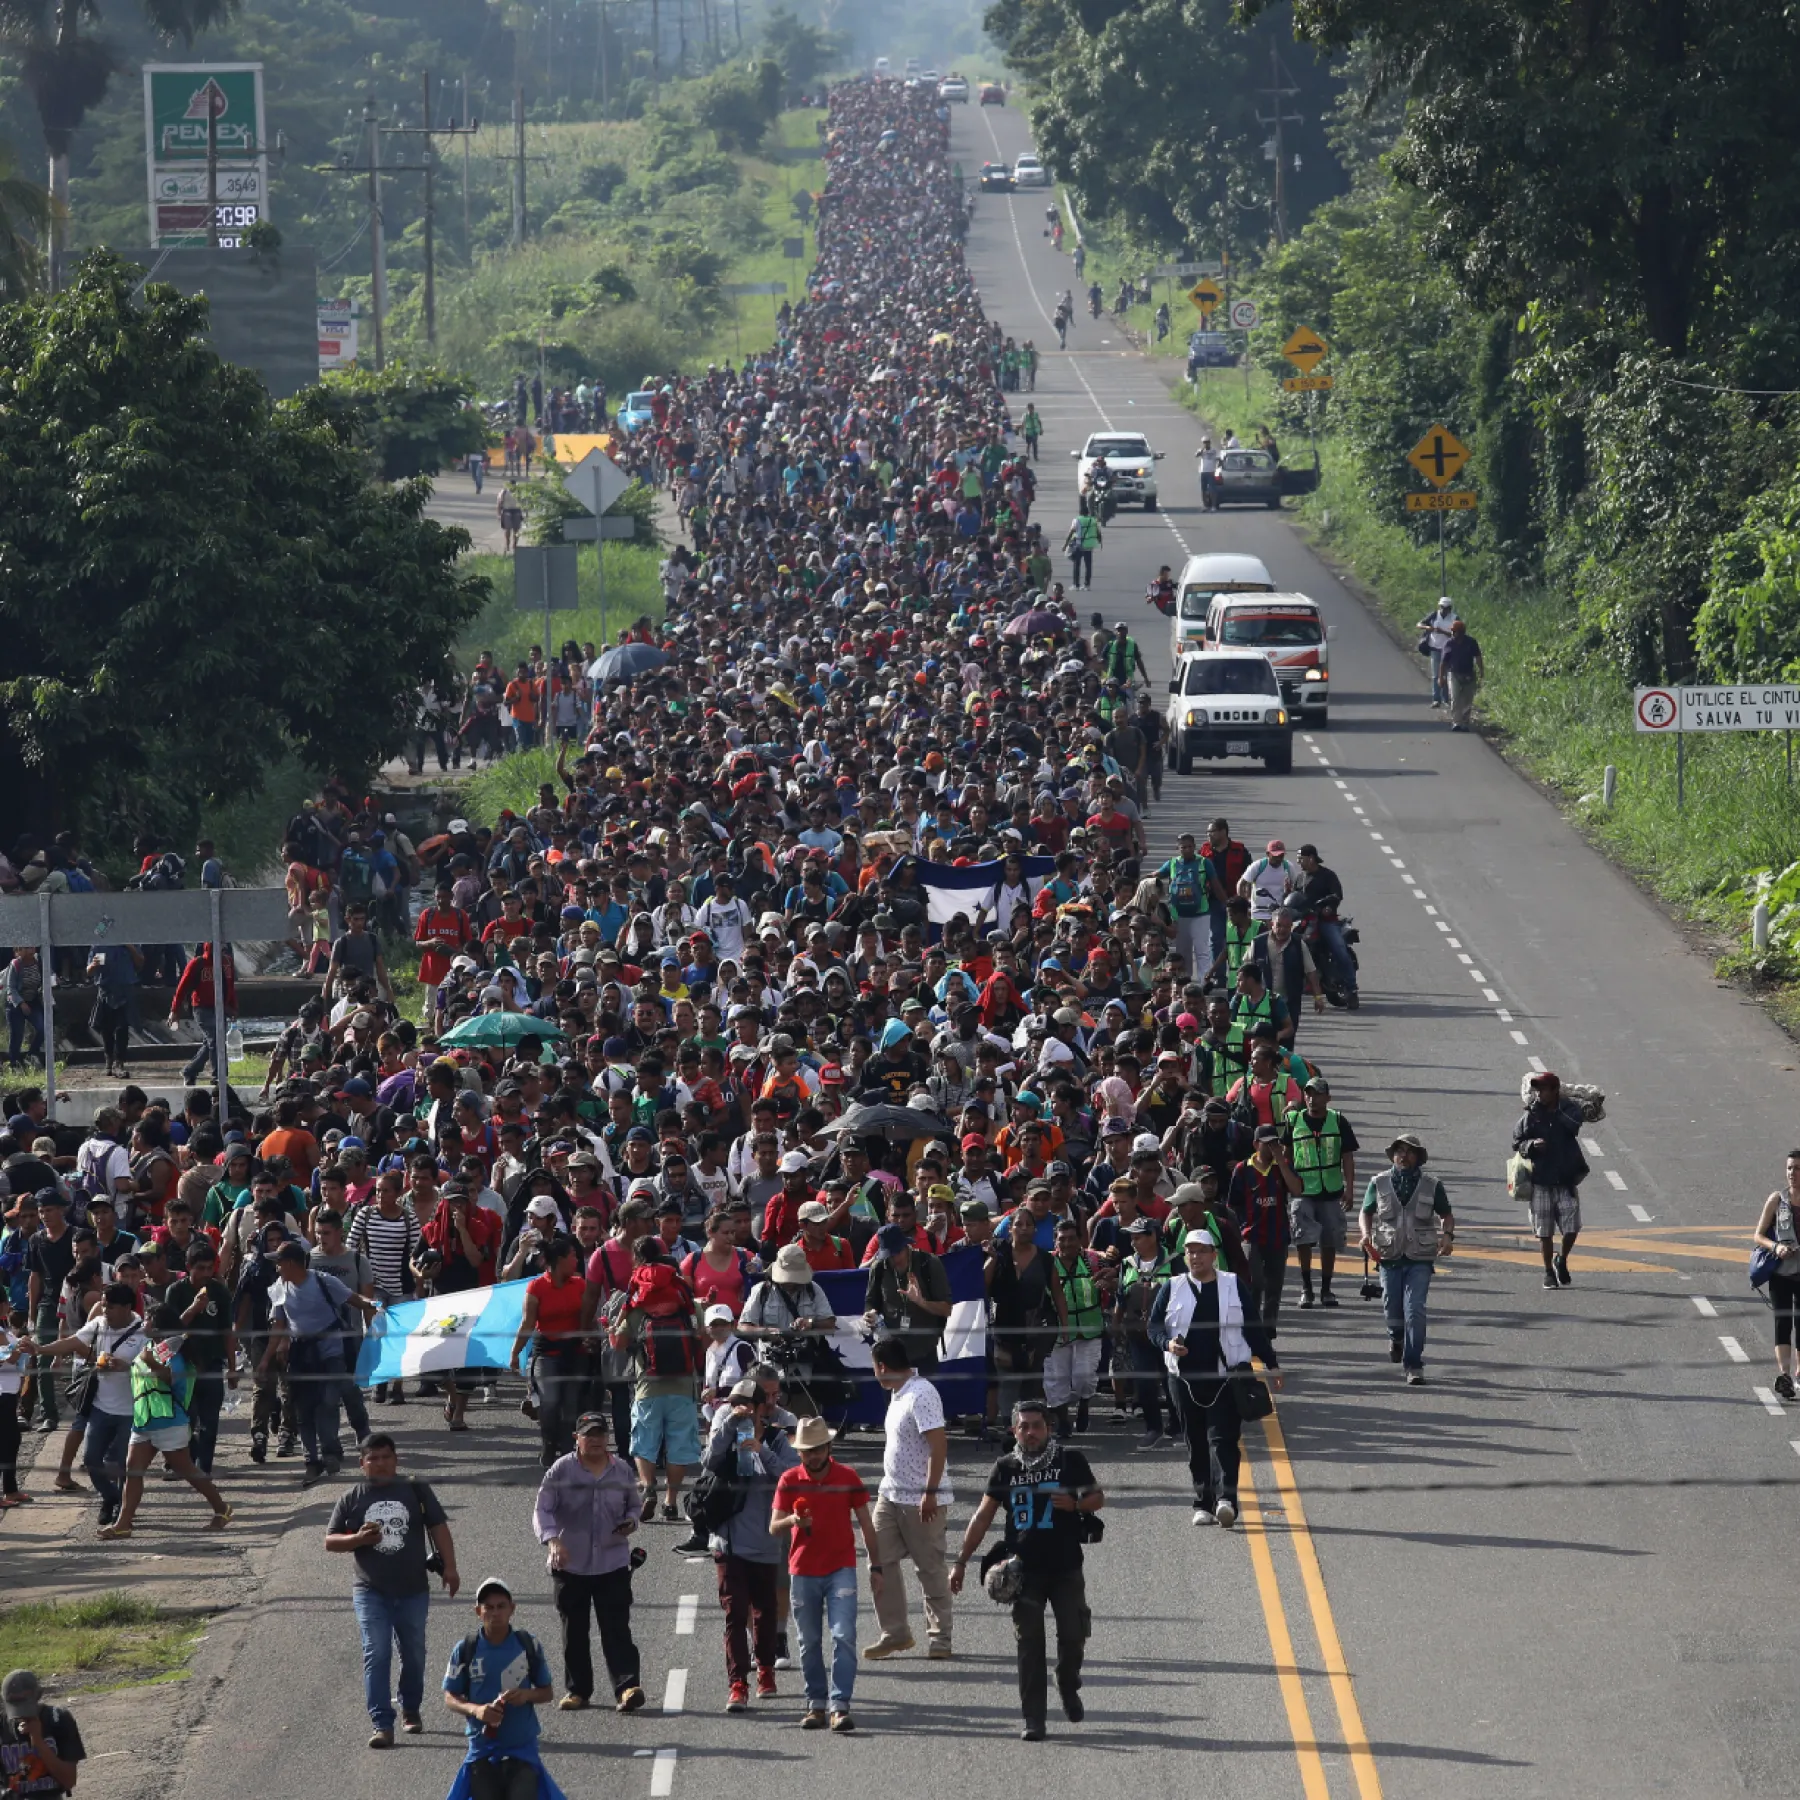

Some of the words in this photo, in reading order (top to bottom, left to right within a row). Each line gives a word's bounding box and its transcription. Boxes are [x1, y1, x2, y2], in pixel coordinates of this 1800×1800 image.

[227, 178, 257, 192] 3549
[1414, 497, 1421, 507] A
[1429, 496, 1453, 507] 250
[1686, 692, 1734, 706] UTILICE
[1740, 691, 1757, 705] EL
[1763, 690, 1800, 704] CINTU
[1696, 711, 1742, 726] SALVA
[1756, 711, 1773, 724] TU
[1785, 711, 1800, 724] VI
